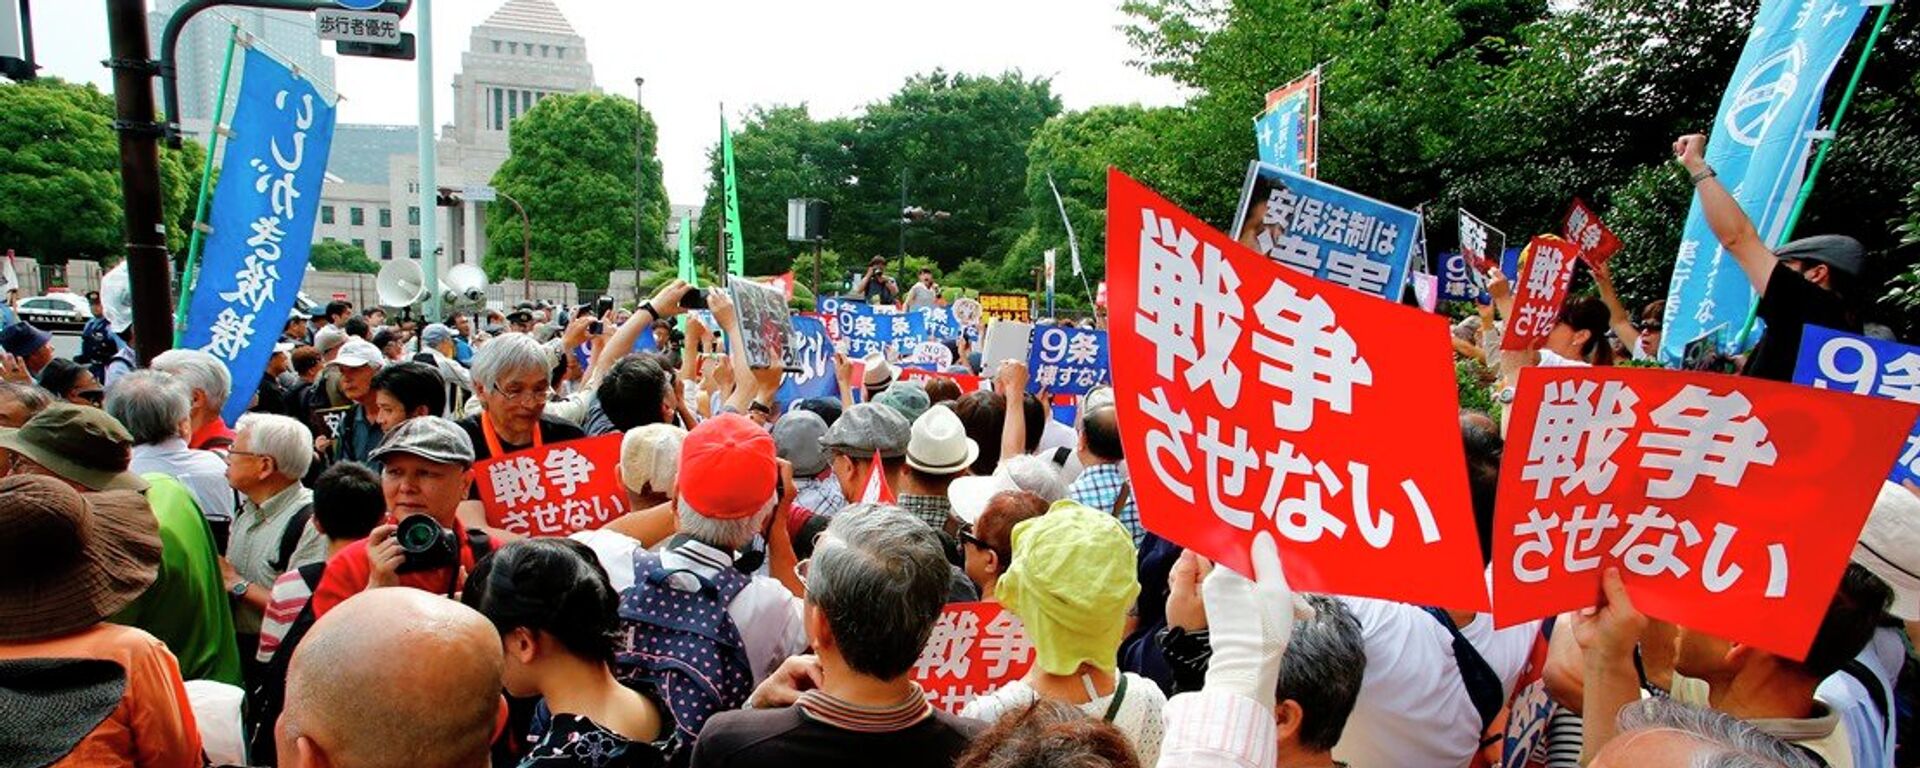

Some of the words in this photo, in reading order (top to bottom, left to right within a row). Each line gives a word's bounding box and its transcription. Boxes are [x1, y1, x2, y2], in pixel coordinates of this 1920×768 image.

[320, 16, 395, 38] 歩行者優先
[1263, 188, 1398, 256] 安保法制は
[29, 315, 71, 323] POLICE
[840, 312, 877, 338] 9条
[1039, 328, 1099, 365] 9条
[1135, 208, 1373, 432] 戦争
[1035, 364, 1107, 388] 壊すな!
[1138, 387, 1441, 549] させない
[1521, 380, 1778, 500] 戦争
[488, 447, 595, 508] 戦争
[501, 494, 624, 535] させない
[1513, 503, 1789, 598] させない
[912, 609, 1034, 680] 戦争
